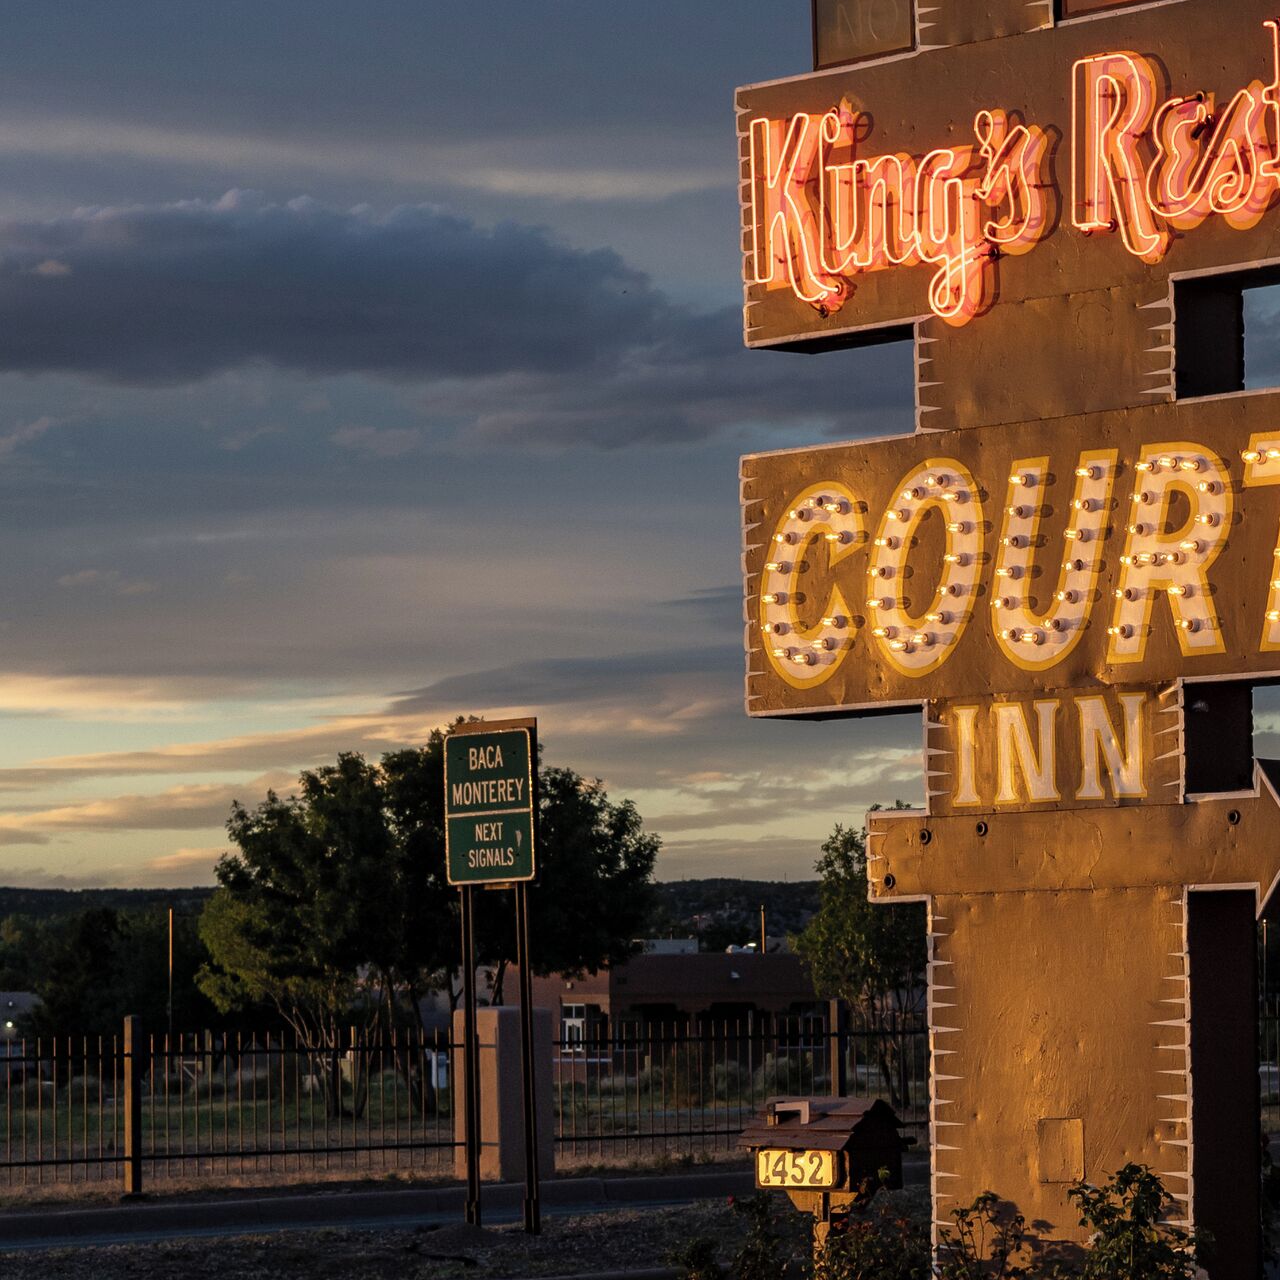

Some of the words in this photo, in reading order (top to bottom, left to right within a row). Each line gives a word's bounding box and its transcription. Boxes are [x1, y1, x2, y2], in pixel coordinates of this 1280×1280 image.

[750, 95, 1048, 326] King's
[469, 745, 503, 770] BACA
[951, 691, 1148, 807] INN
[452, 778, 524, 806] MONTEREY
[475, 822, 504, 842] NEXT
[468, 847, 514, 868] SIGNALS
[761, 1151, 824, 1185] 1452
